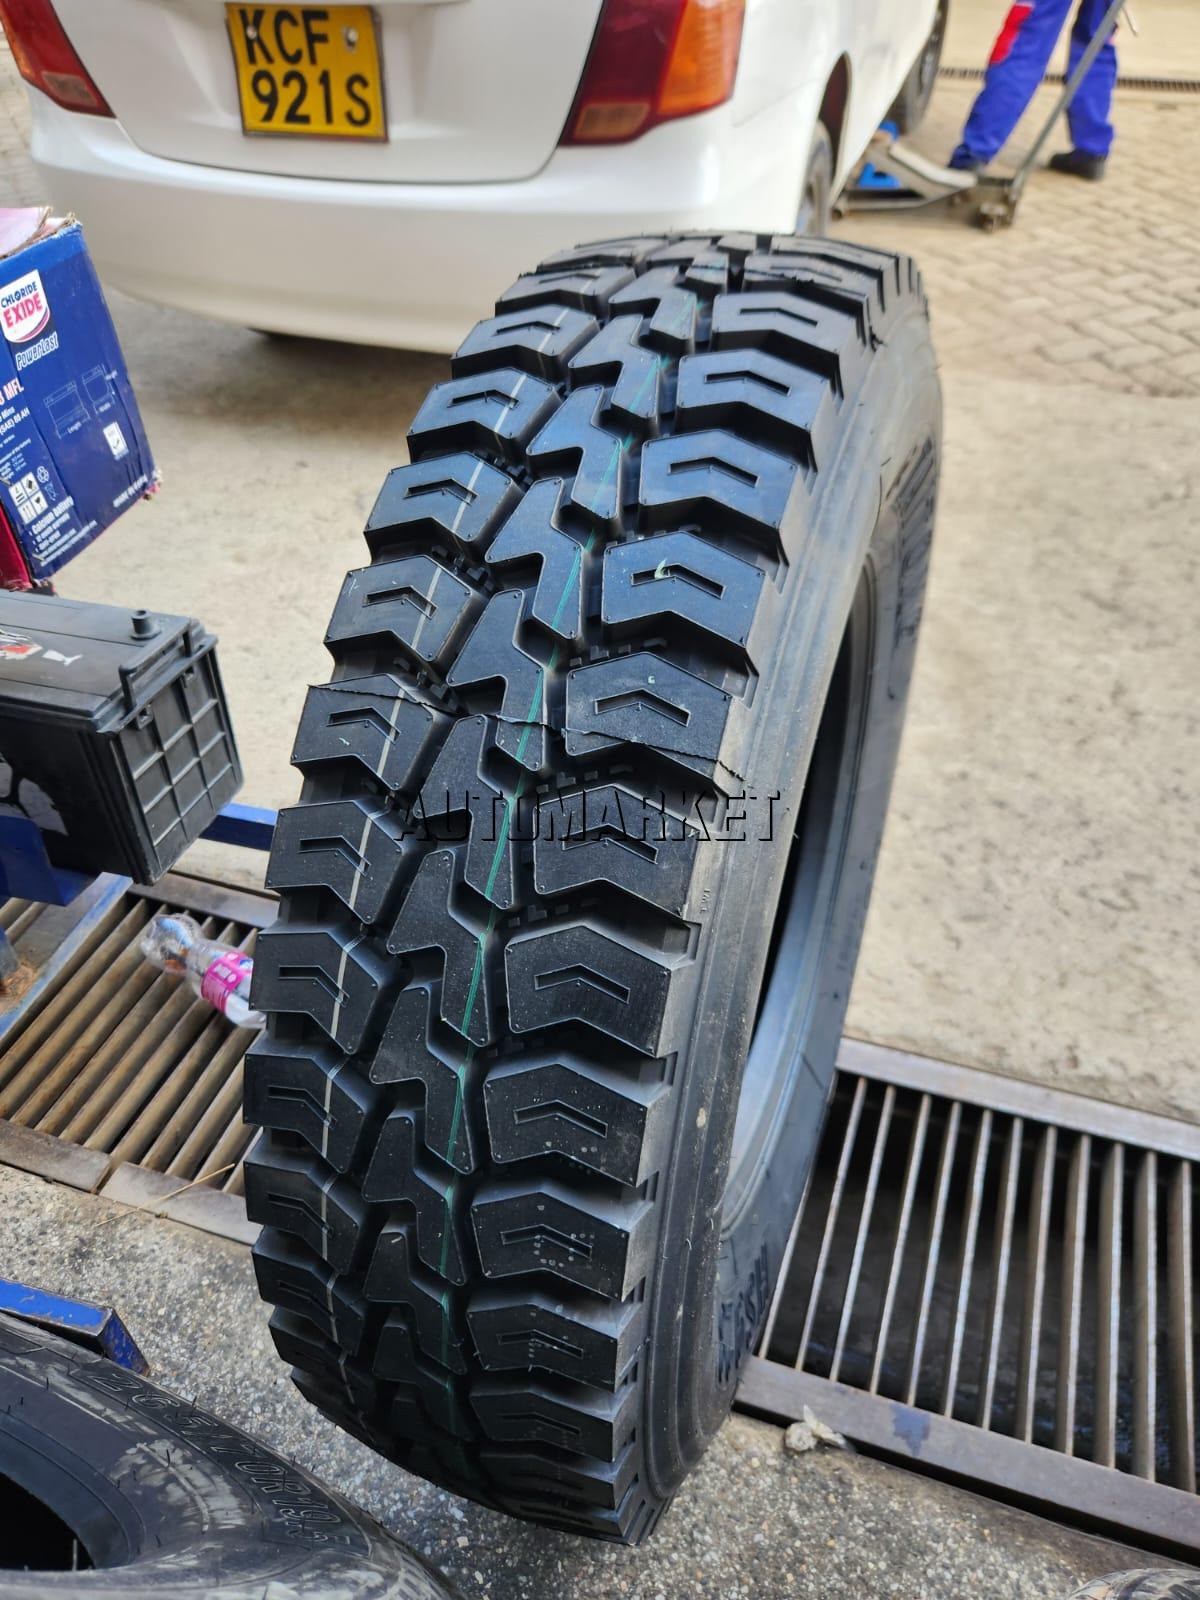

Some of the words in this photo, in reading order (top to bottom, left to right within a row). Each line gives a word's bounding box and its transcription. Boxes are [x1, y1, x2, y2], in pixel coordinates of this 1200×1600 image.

[238, 9, 329, 65] KCF
[251, 69, 371, 127] 921S
[1, 281, 38, 308] CHLORIDE
[3, 292, 43, 328] EXIDE
